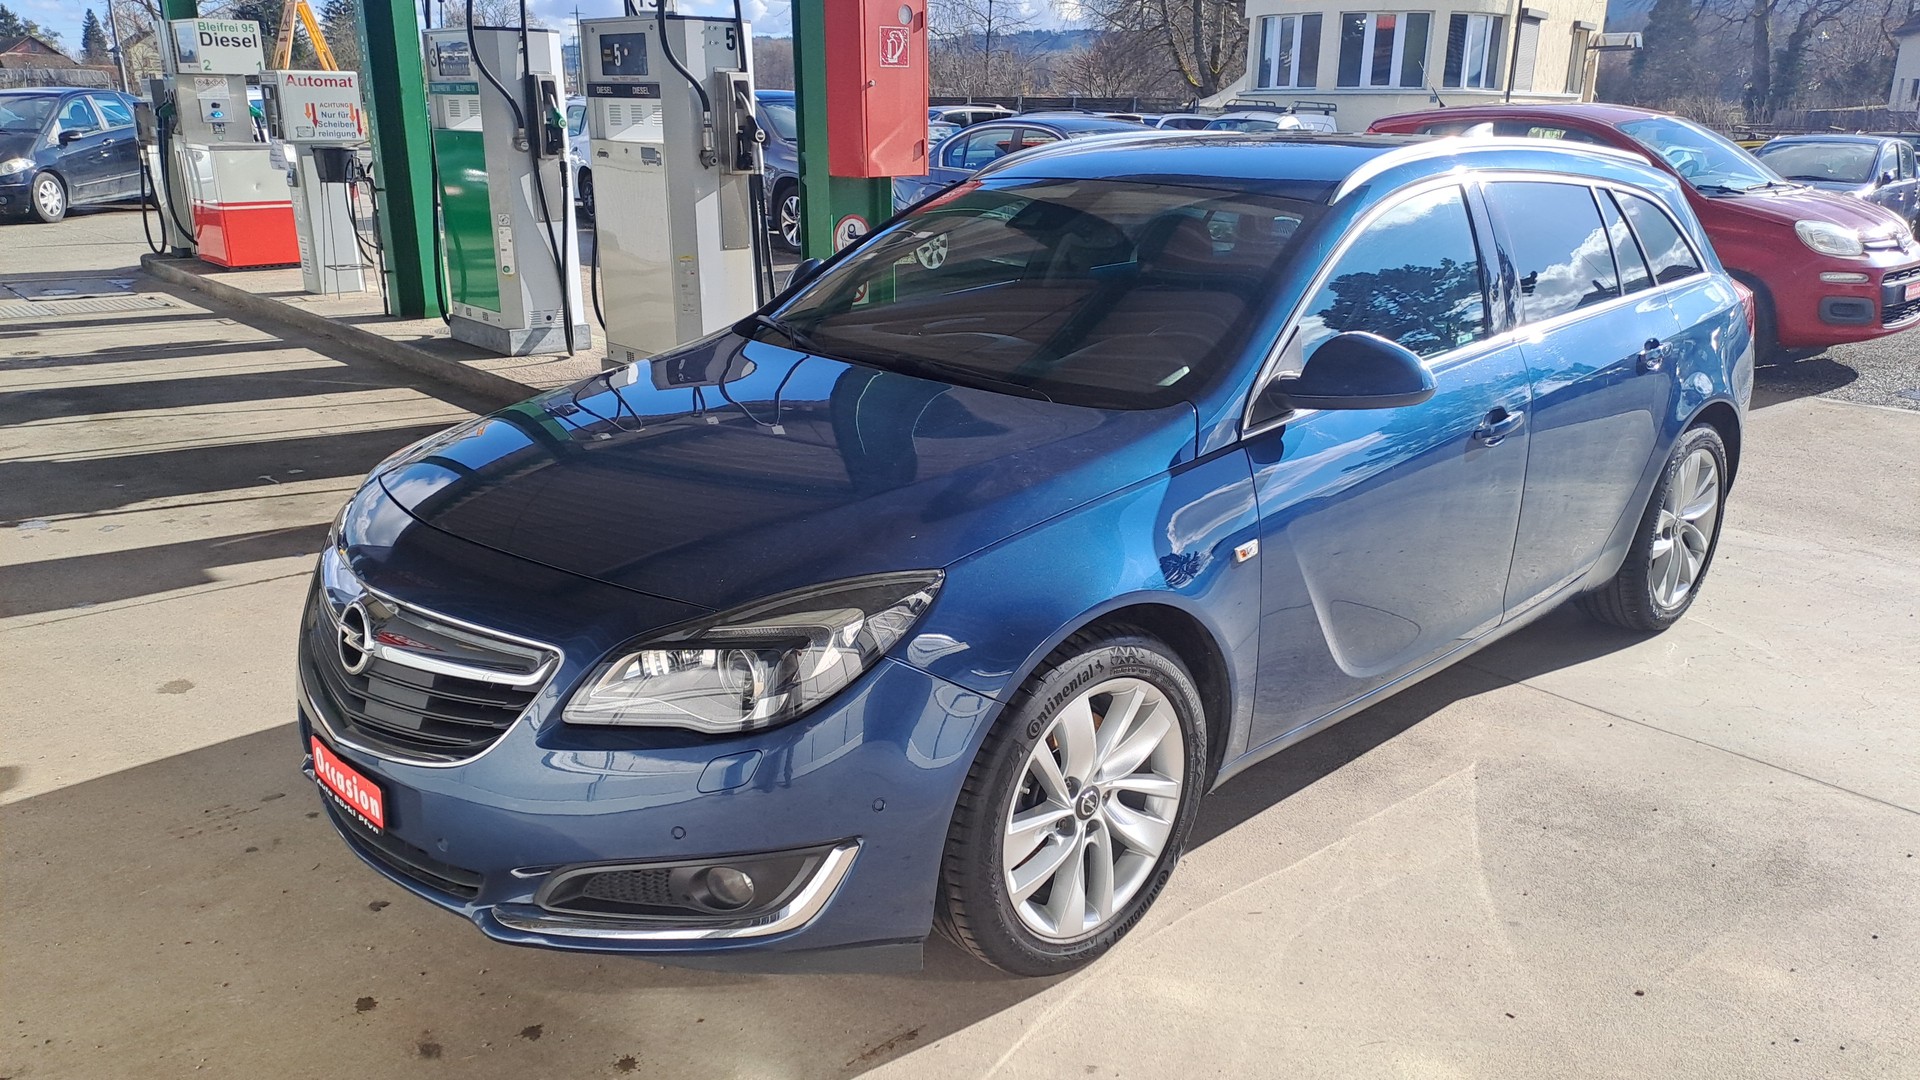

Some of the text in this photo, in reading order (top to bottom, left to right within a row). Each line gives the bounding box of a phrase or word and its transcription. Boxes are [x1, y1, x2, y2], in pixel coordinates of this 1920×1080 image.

[197, 21, 255, 33] Bleifrei 95
[199, 32, 258, 48] Diesel
[725, 27, 736, 51] 5
[429, 48, 438, 68] 3
[613, 43, 622, 67] 5
[202, 59, 212, 71] 2
[285, 74, 353, 88] Automat
[596, 86, 613, 94] DIESEL
[632, 86, 650, 95] DIESEL
[318, 130, 357, 138] reinigung
[1026, 663, 1094, 740] Continental
[315, 746, 381, 820] Occasion
